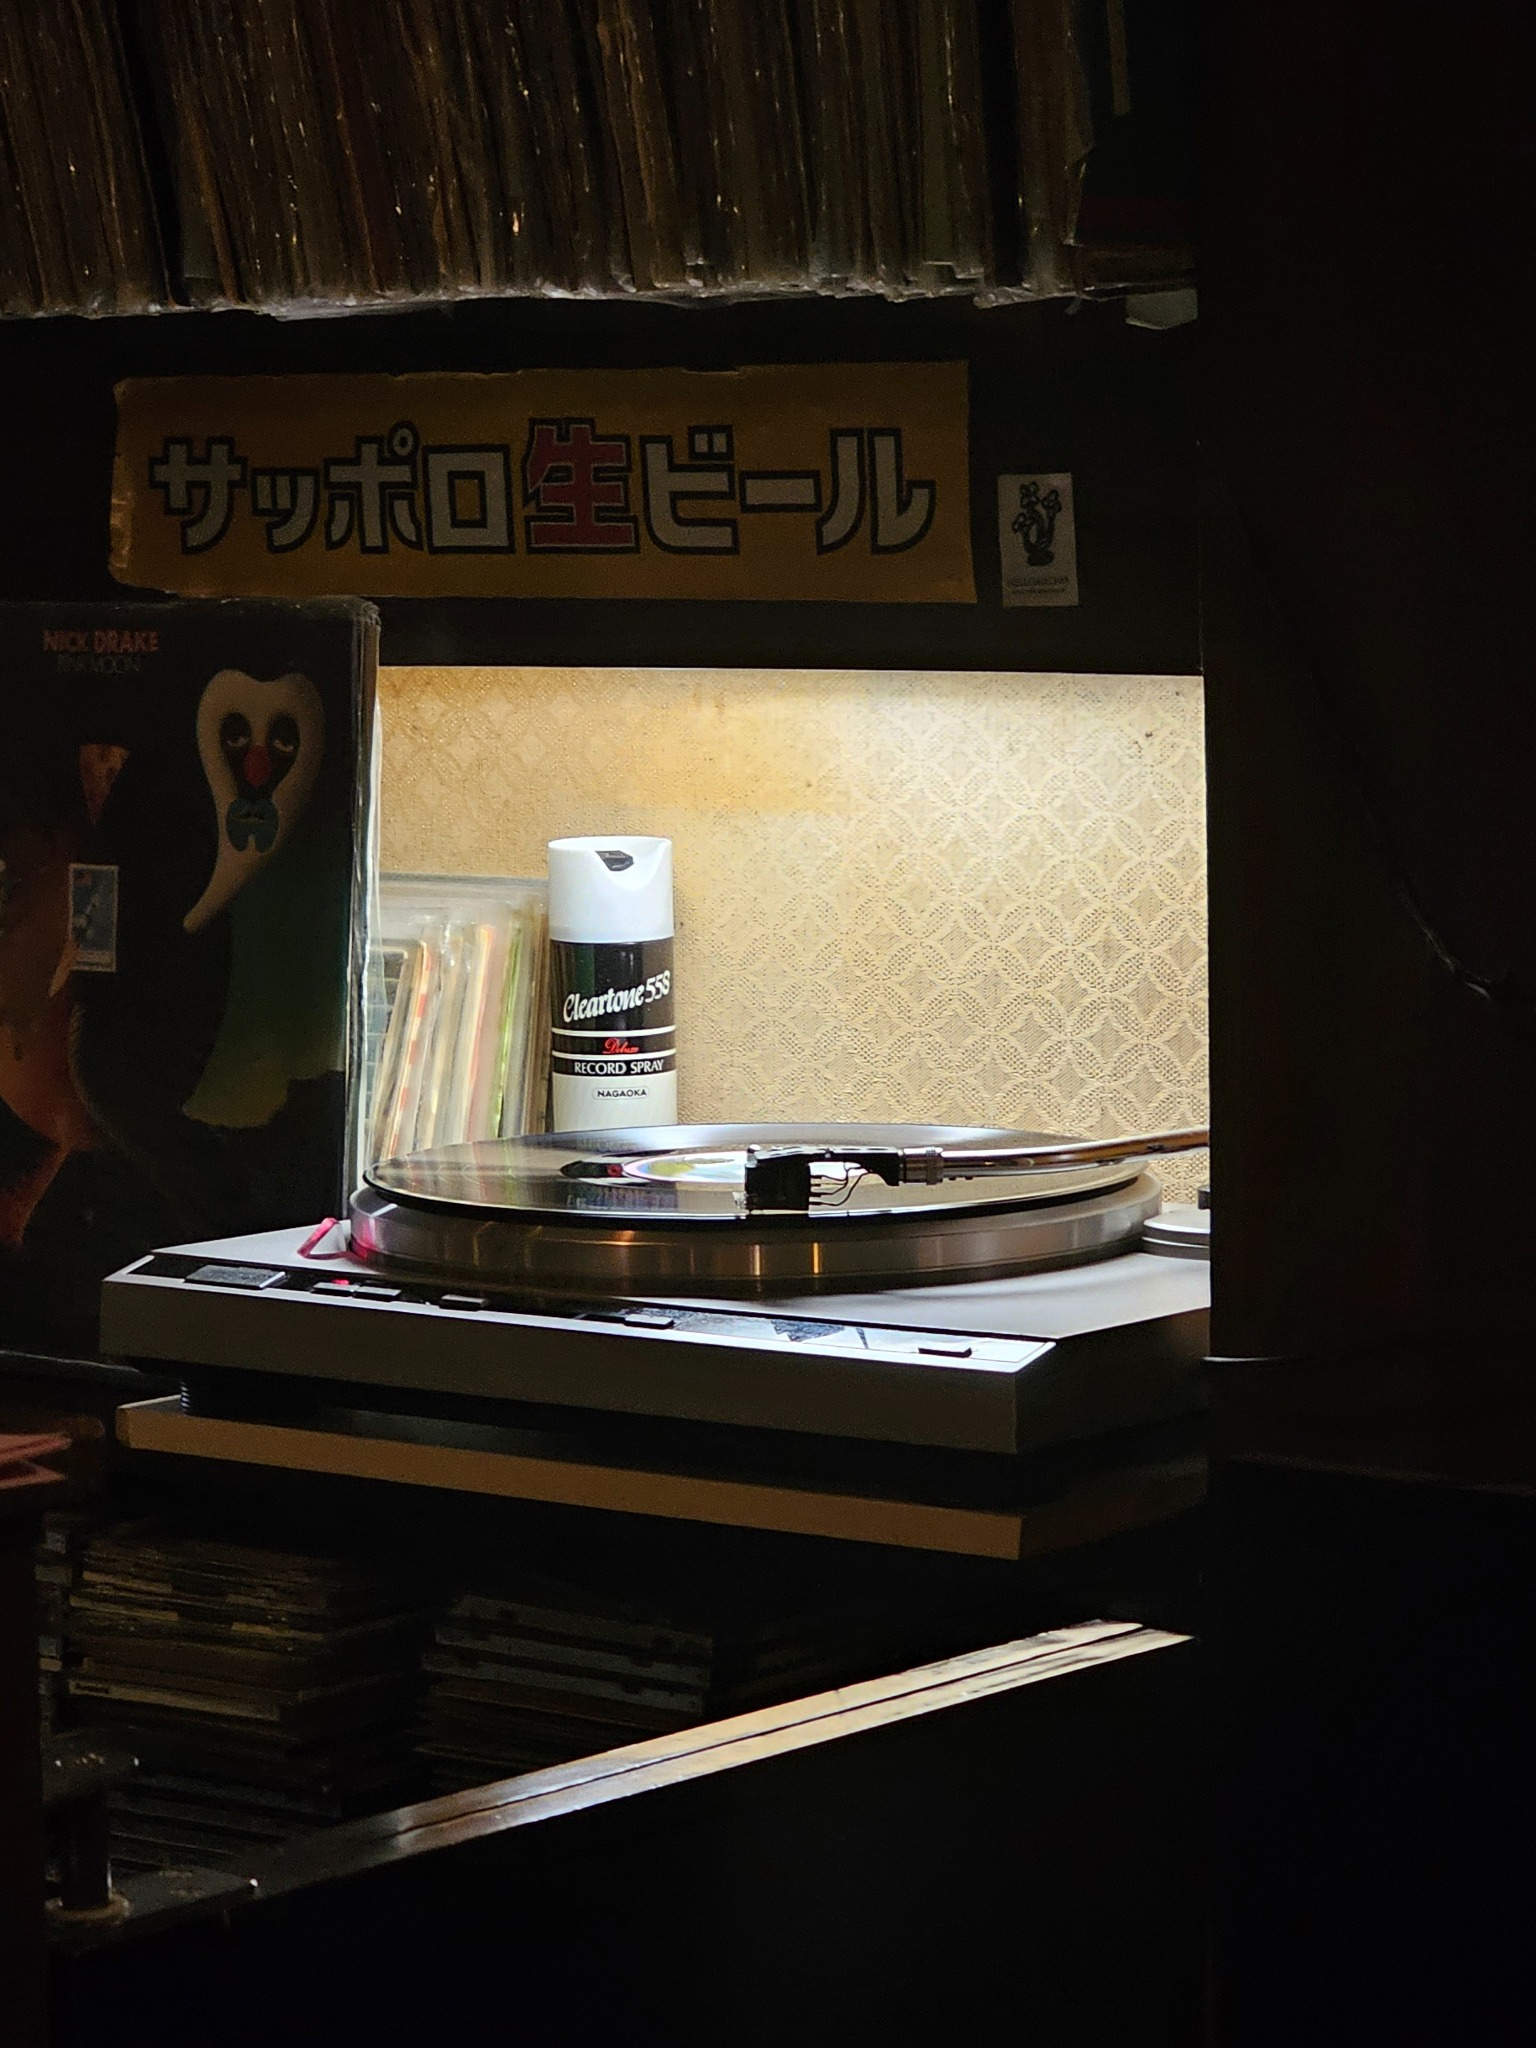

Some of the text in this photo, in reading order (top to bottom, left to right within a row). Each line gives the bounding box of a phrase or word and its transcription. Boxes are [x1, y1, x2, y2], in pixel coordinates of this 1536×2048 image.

[149, 418, 937, 555] サッポロ生ビール
[43, 630, 160, 653] NICK DRAKE
[563, 970, 670, 1022] Cleartone 558
[574, 1059, 664, 1075] RECORD SPRAY
[597, 1089, 647, 1098] NAGAOKA
